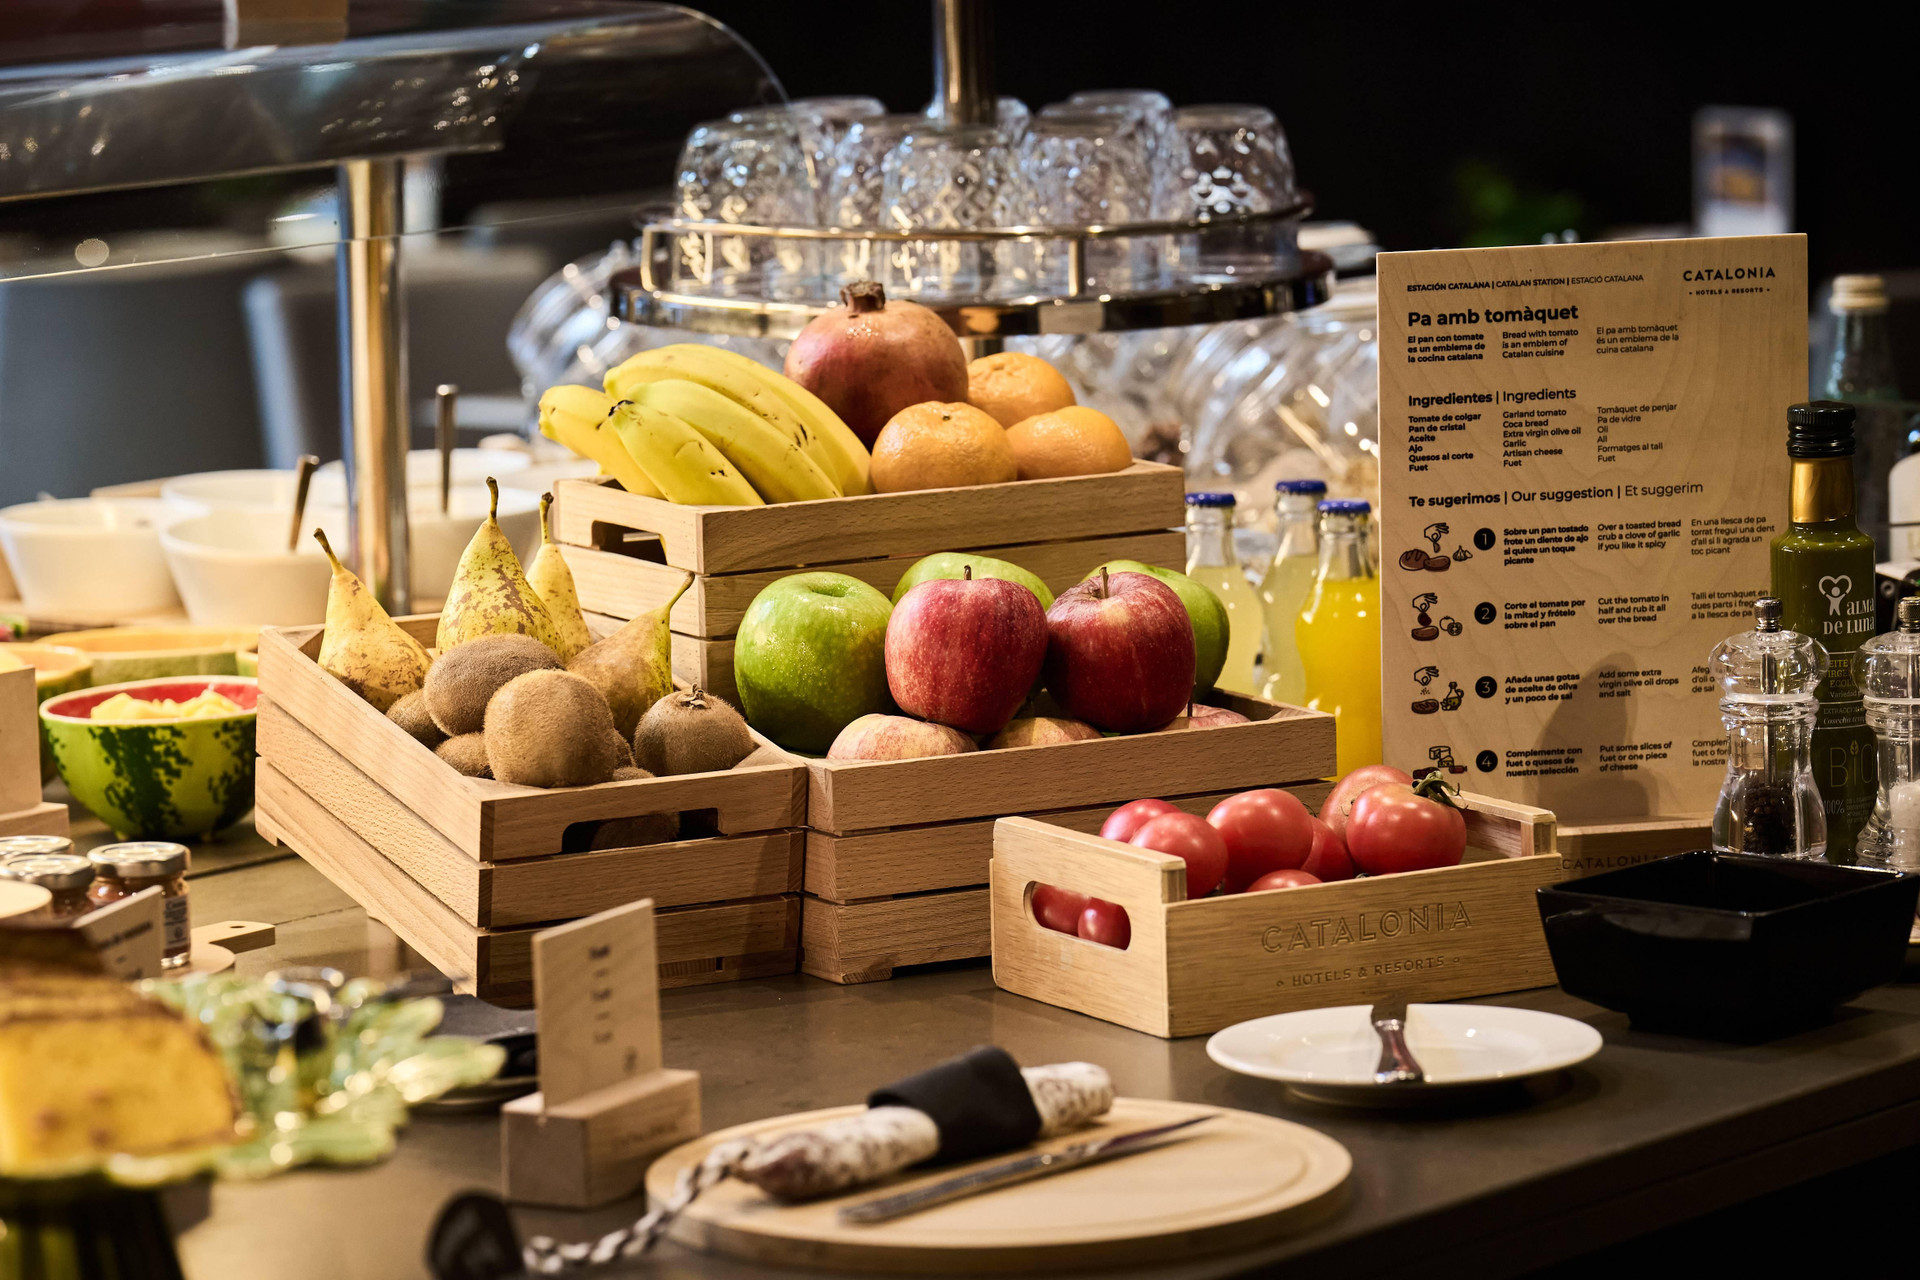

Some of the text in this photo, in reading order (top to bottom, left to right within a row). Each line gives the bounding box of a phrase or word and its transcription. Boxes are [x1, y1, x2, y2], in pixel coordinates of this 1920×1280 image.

[1683, 267, 1776, 282] CATALONIA
[1407, 275, 1644, 292] ESTACIÓN CATALANA CATALAN STATION ESTACIÓ CATALANA
[1408, 305, 1579, 327] Pa amb tomàquet
[1502, 329, 1579, 339] Bread with tomato
[1596, 324, 1678, 336] El pa amb tomàquet
[1407, 336, 1416, 344] El
[1417, 336, 1434, 345] pan
[1453, 333, 1485, 342] tomate
[1502, 341, 1510, 349] is
[1522, 339, 1558, 348] emblem
[1559, 338, 1568, 346] of
[1596, 336, 1606, 345] és
[1619, 335, 1659, 344] emblema
[1659, 334, 1671, 342] de
[1432, 344, 1473, 352] emblema
[1474, 342, 1486, 350] de
[1596, 344, 1654, 354] cuina catalana
[1407, 353, 1484, 363] la cocina catalana
[1502, 348, 1565, 359] Catalan cuisine
[1408, 388, 1577, 409] Ingredientes Ingredients
[1502, 409, 1567, 419] Garland tomato
[1597, 403, 1678, 415] Tomàquet de penjar
[1408, 413, 1482, 423] Tomate de colgar
[1597, 415, 1642, 424] Pa de vidre
[1408, 423, 1466, 433] Pan de cristal
[1502, 419, 1549, 429] Coca bread
[1408, 434, 1436, 443] Aceite
[1503, 427, 1582, 439] Extra virgin olive oil
[1408, 444, 1424, 454] Ajo
[1502, 439, 1527, 448] Garlic
[1597, 442, 1664, 453] Formatges al tall
[1408, 452, 1474, 463] Quesos al corte
[1502, 448, 1563, 458] Artisan cheese
[1409, 464, 1429, 472] Fuet
[1503, 459, 1522, 468] Fuet
[1408, 482, 1703, 508] Te sugerimos Our suggestion Et suggerim
[1481, 607, 1490, 619] 2
[1482, 681, 1490, 694] 3
[1482, 755, 1492, 767] 4
[1261, 901, 1472, 954] CATALONIA
[1292, 955, 1445, 987] HOTELS & RESORTS
